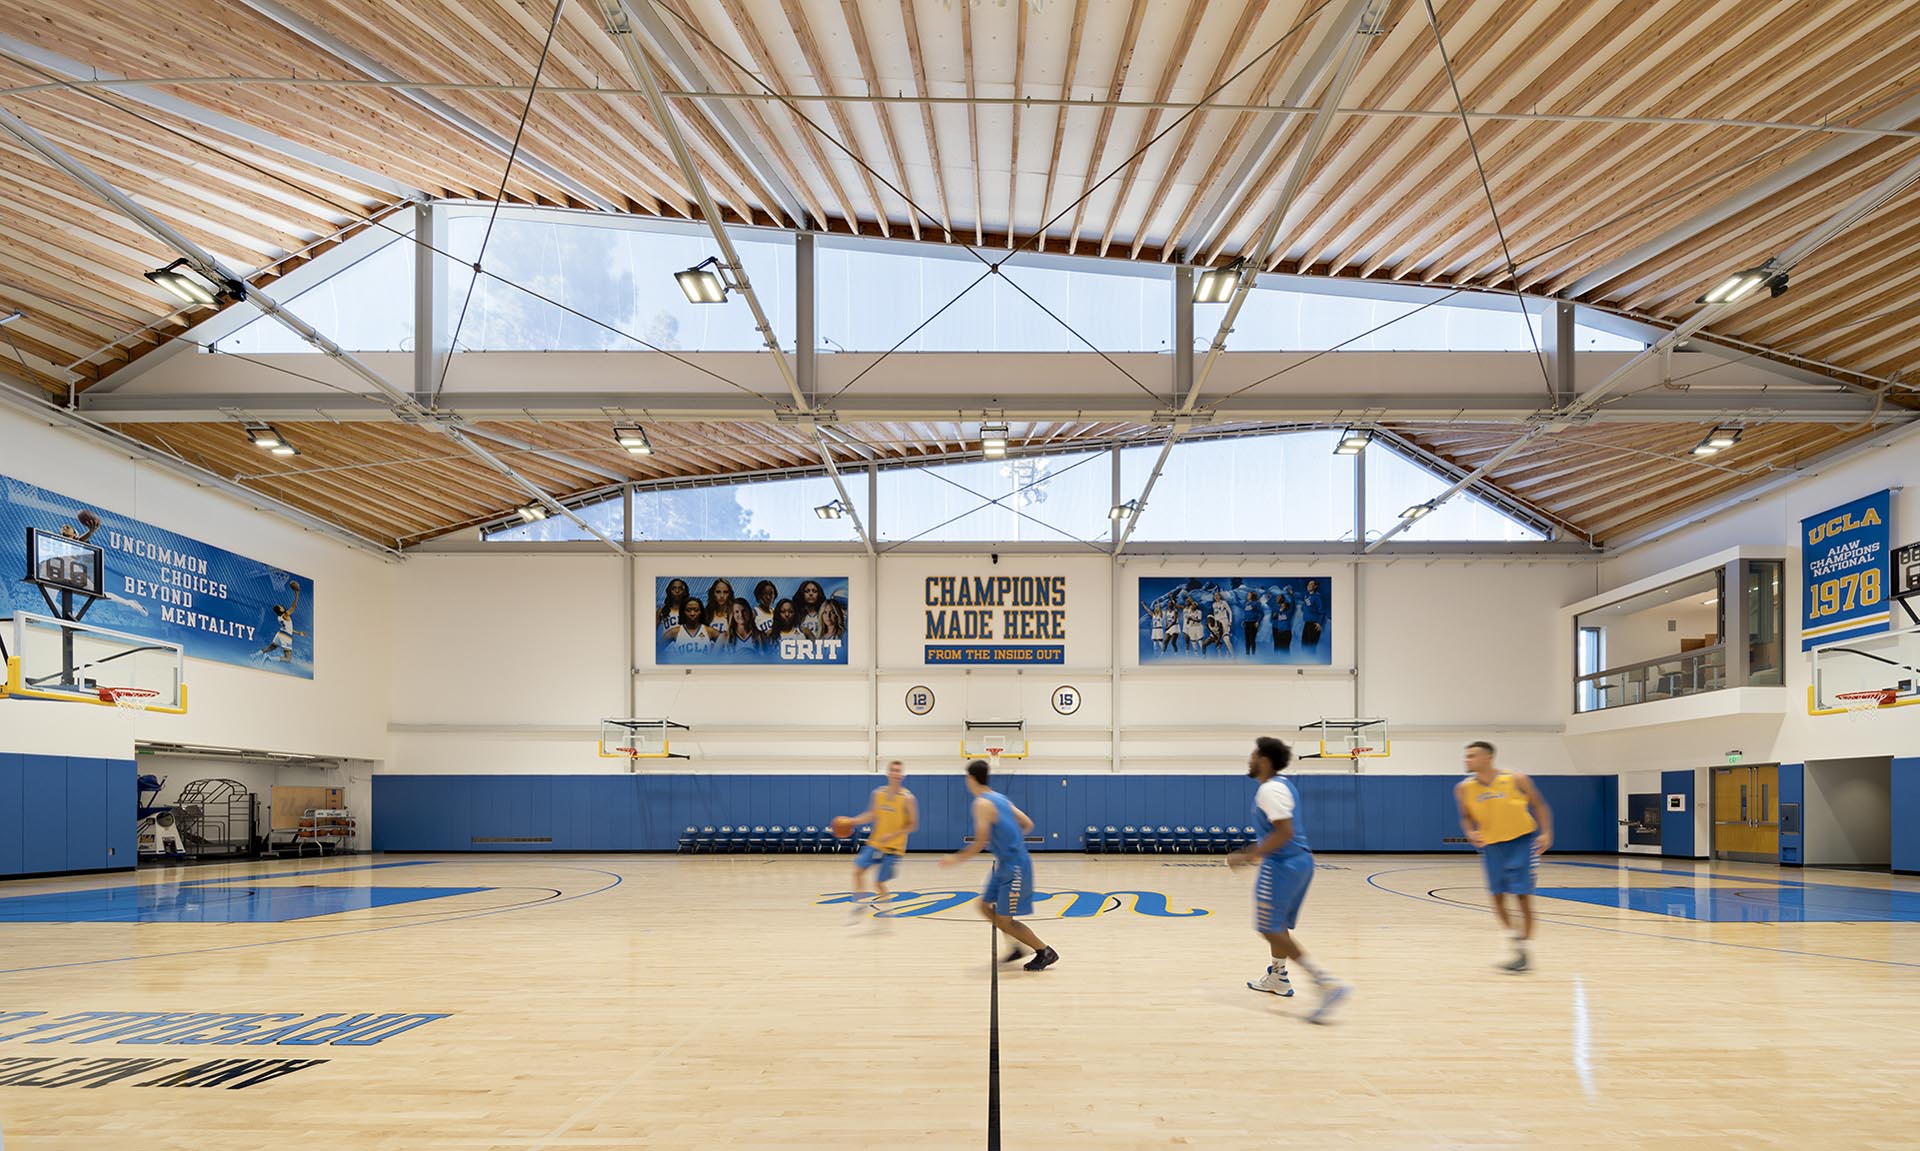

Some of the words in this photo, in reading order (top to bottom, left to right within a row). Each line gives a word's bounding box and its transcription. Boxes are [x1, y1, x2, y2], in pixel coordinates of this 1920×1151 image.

[1808, 507, 1882, 545] UCLA
[109, 532, 208, 575] UNCOMMON
[1810, 542, 1880, 570] CHAMPIONS
[1827, 539, 1861, 557] AIAW
[1813, 554, 1875, 577] NATIONAL
[124, 575, 193, 608] BEYOND
[160, 569, 228, 599] CHOICES
[925, 576, 1066, 606] CHAMPIONS
[1809, 568, 1881, 619] 1978
[161, 605, 256, 641] MENTALITY
[925, 610, 993, 639] MADE
[1003, 610, 1066, 639] HERE
[780, 639, 842, 660] GRIT
[928, 649, 962, 660] FROM
[965, 649, 990, 660] THE
[994, 649, 1033, 660] INSIDE
[1036, 649, 1061, 660] OUT
[912, 693, 927, 706] 12
[1059, 693, 1073, 706] 15
[814, 890, 1214, 919] Ula
